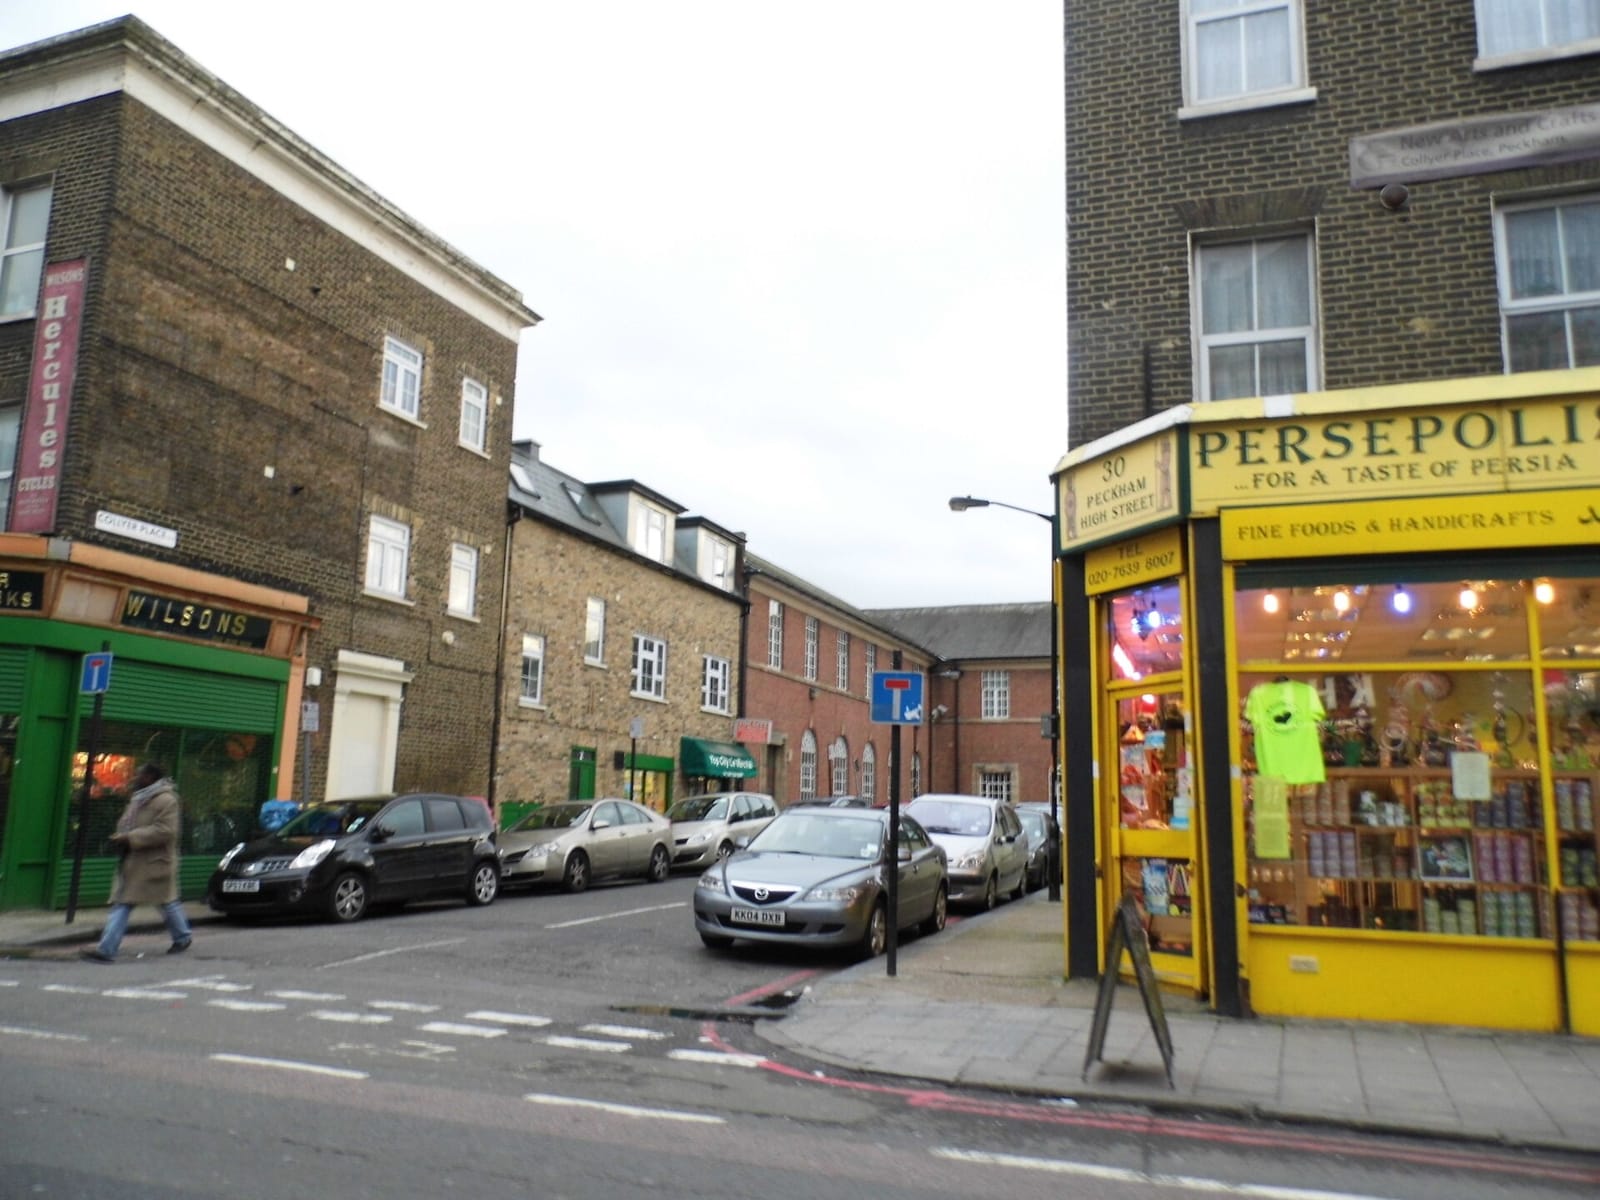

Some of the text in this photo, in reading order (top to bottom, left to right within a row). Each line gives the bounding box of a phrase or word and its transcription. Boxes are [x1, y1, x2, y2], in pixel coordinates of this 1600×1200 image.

[1400, 110, 1598, 151] New Arts and Crafts
[1401, 151, 1449, 168] Collyer
[39, 296, 67, 468] Hercules
[1196, 403, 1600, 468] PERSEPOLI
[18, 475, 55, 492] CYCLES
[1101, 455, 1126, 482] 30
[1310, 469, 1330, 486] A
[1342, 462, 1421, 484] TASTE
[1430, 460, 1459, 477] OF
[1471, 453, 1577, 476] PERSIA
[1087, 476, 1146, 508] PECKHAM
[98, 514, 137, 529] COLLYER
[1080, 494, 1155, 529] HIGH STREET
[1238, 509, 1554, 541] FINE FOODS & HANDICRAFTS
[1118, 543, 1143, 560] TEL
[127, 595, 247, 635] WILSONS
